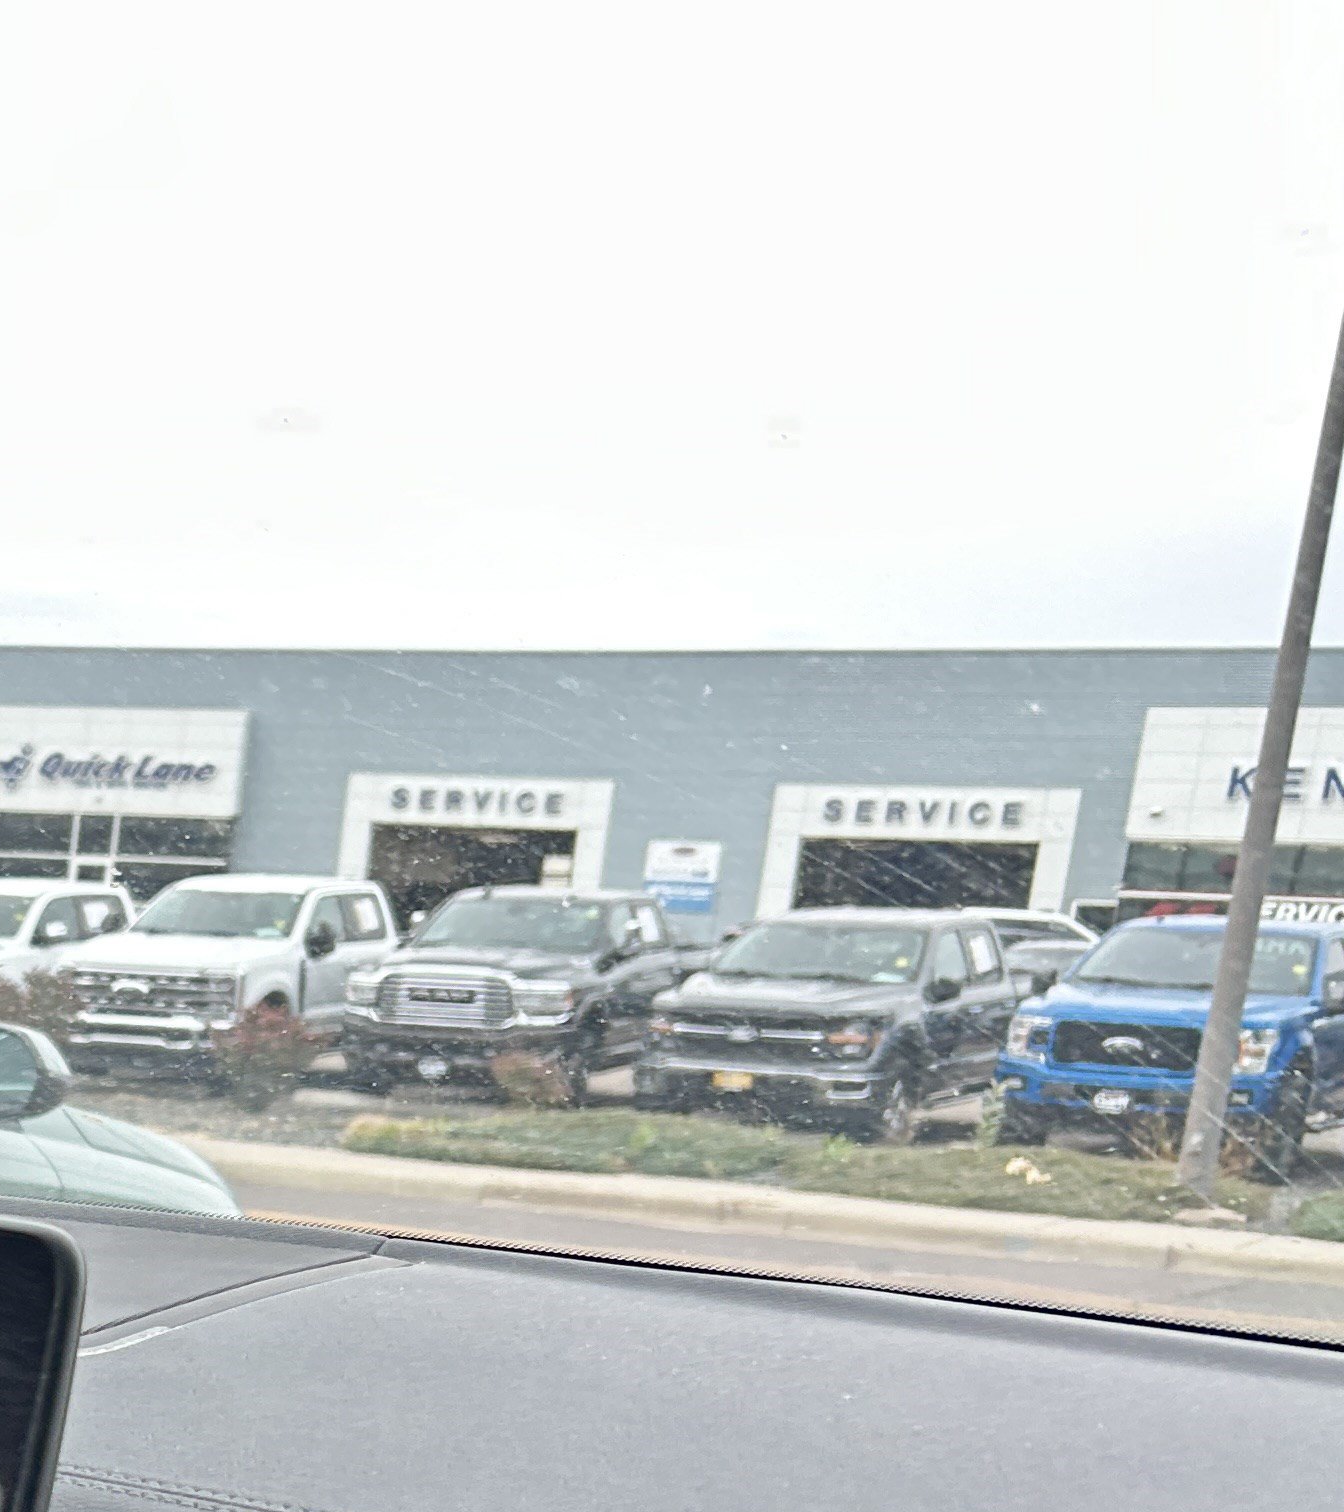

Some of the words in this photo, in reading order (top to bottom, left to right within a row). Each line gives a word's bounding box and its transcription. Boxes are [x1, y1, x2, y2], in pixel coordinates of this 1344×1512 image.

[39, 751, 132, 783] Quick
[134, 754, 218, 783] Lane
[390, 785, 567, 817] SERVICE
[823, 798, 1025, 828] SERVICE
